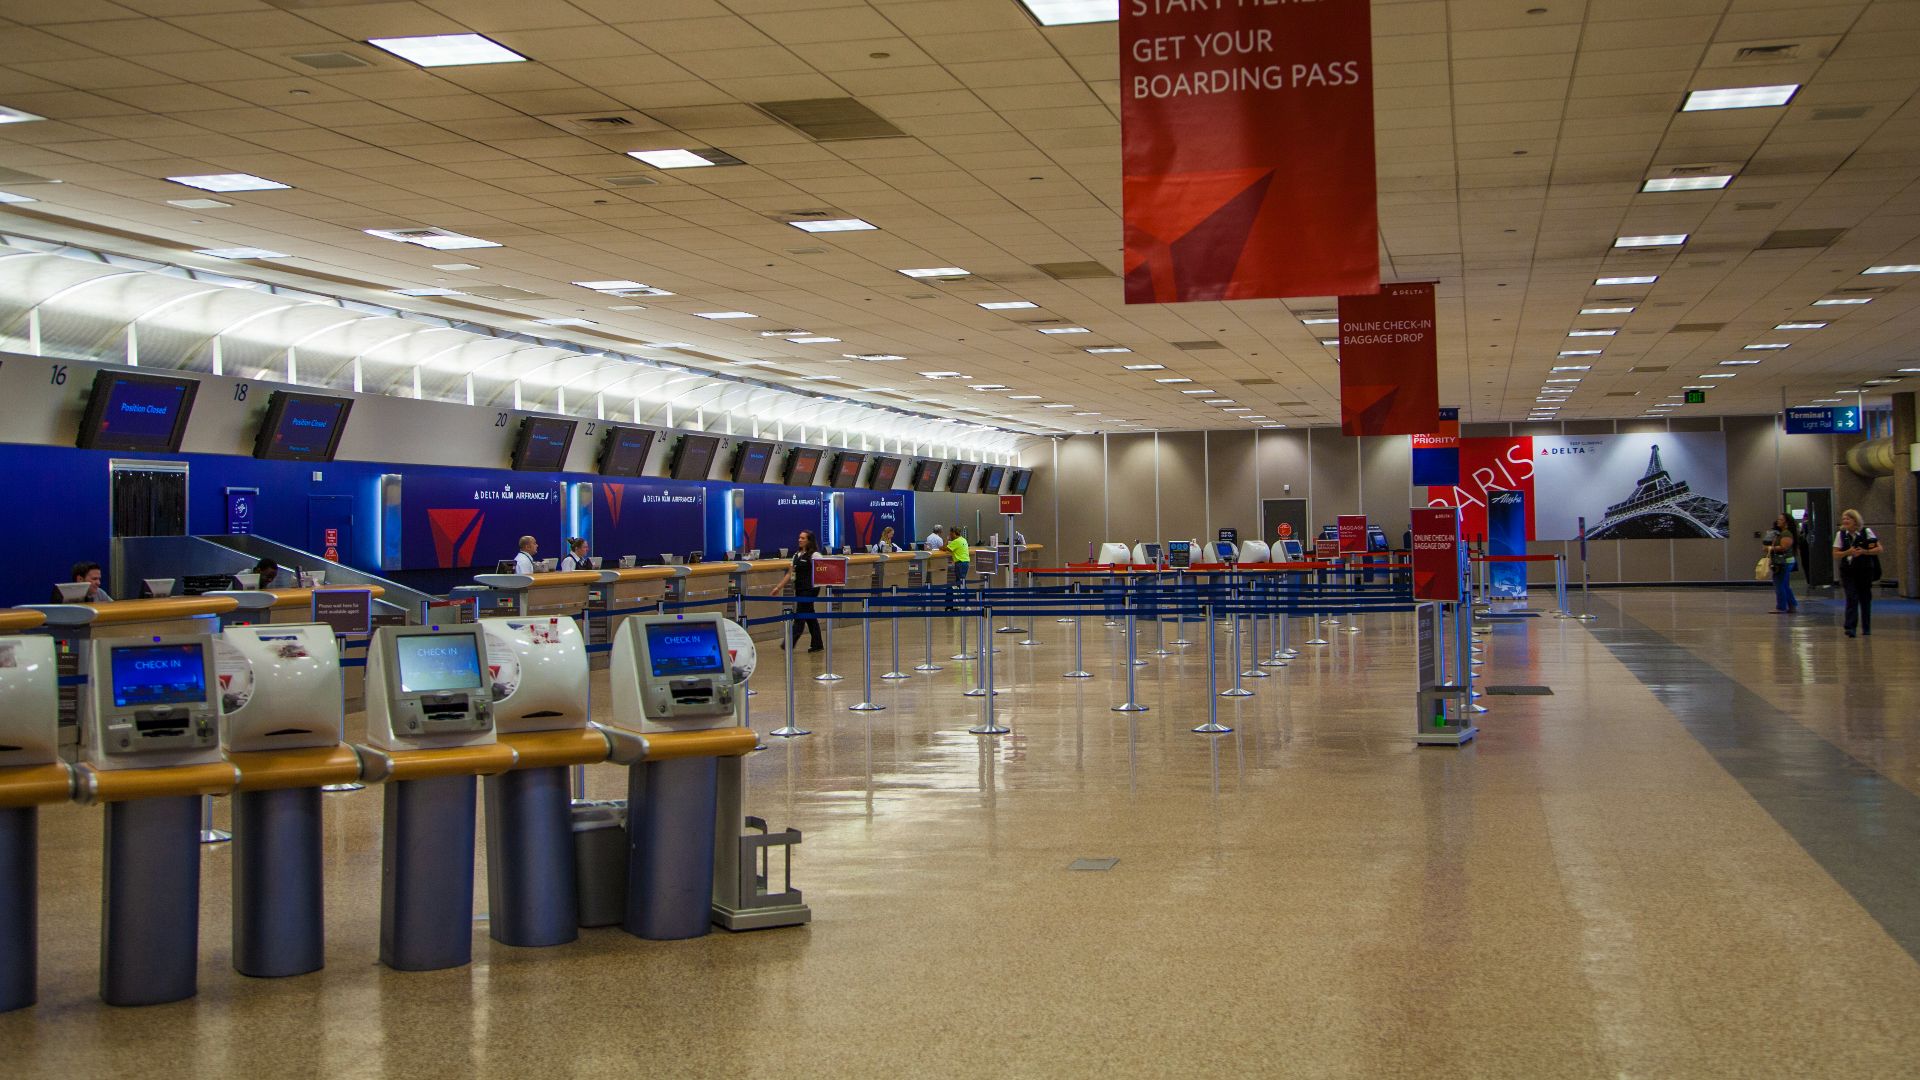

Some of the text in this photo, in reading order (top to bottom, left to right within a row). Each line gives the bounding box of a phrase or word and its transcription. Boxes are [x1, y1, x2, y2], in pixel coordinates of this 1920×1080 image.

[1133, 29, 1273, 62] GET YOUR
[1134, 61, 1360, 98] BOARDING PASS
[1343, 319, 1432, 332] ONLINE CHECK-IN
[1344, 333, 1424, 345] BAGGAGE DROP
[50, 364, 68, 386] 16
[234, 383, 249, 402] 18
[1688, 392, 1703, 403] EXIT
[121, 403, 168, 414] Position Closed
[495, 413, 508, 428] 20
[1790, 411, 1825, 419] Terminal
[585, 422, 596, 436] 22
[1802, 421, 1818, 429] Light
[657, 430, 668, 443] 24
[1551, 447, 1586, 455] DELTA
[480, 491, 500, 500] DELTA
[501, 491, 514, 500] KLM
[646, 495, 661, 503] DELTA
[1413, 534, 1431, 542] ONLINE
[664, 635, 700, 645] CHECK IN
[417, 647, 457, 657] CHECK IN
[135, 660, 181, 670] CHECK IN
